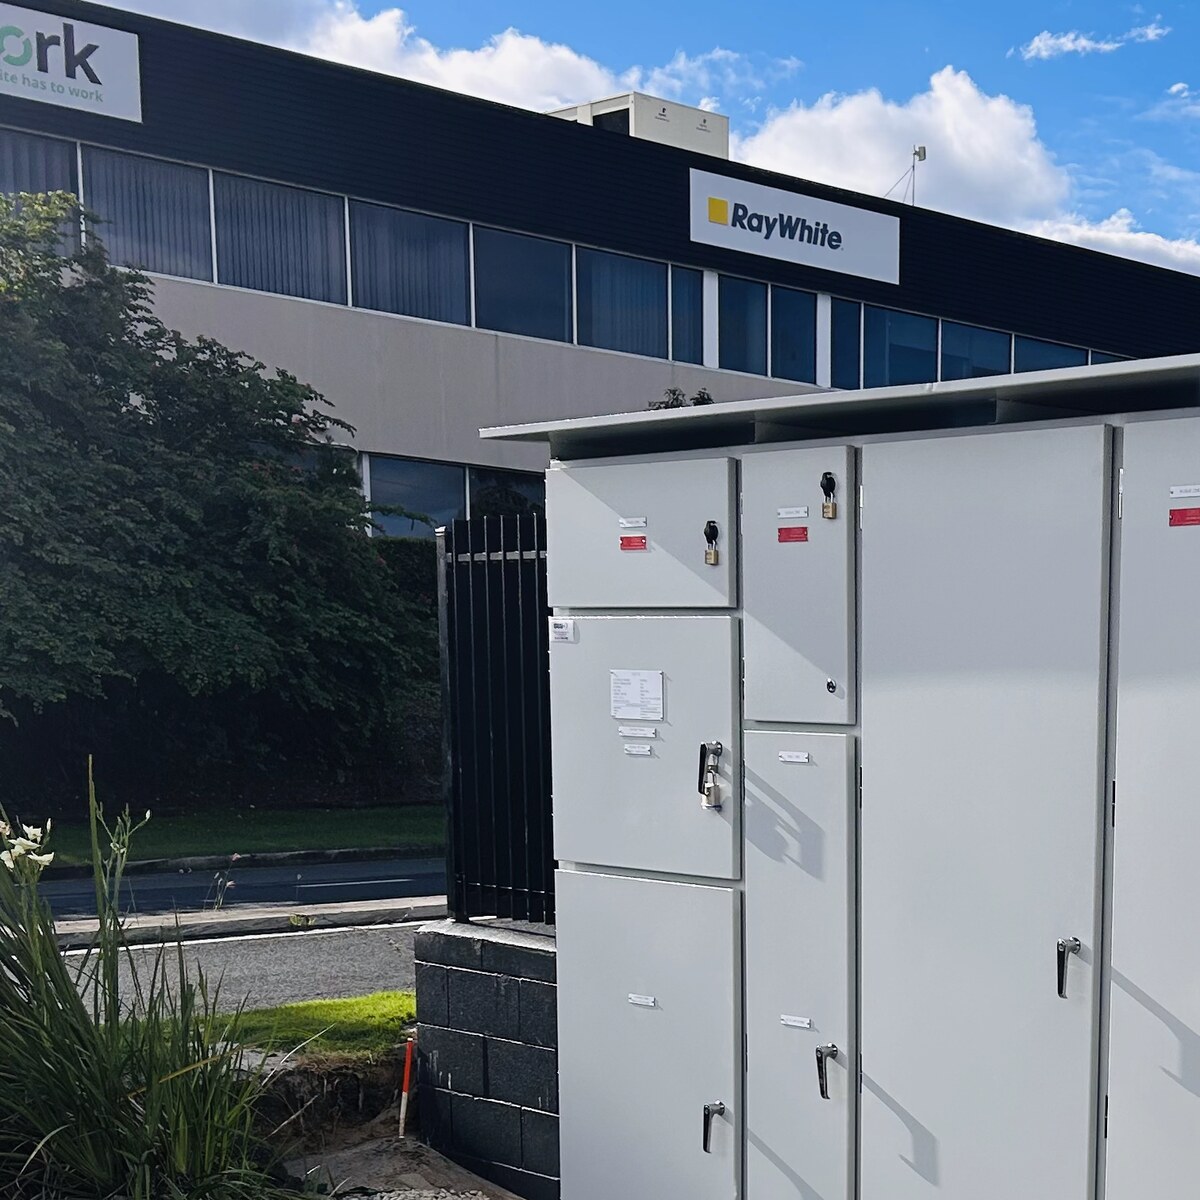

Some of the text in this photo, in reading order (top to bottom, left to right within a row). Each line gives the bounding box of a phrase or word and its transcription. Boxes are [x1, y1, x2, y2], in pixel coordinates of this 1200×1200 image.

[22, 73, 47, 90] has
[51, 81, 65, 94] to
[68, 86, 104, 102] work
